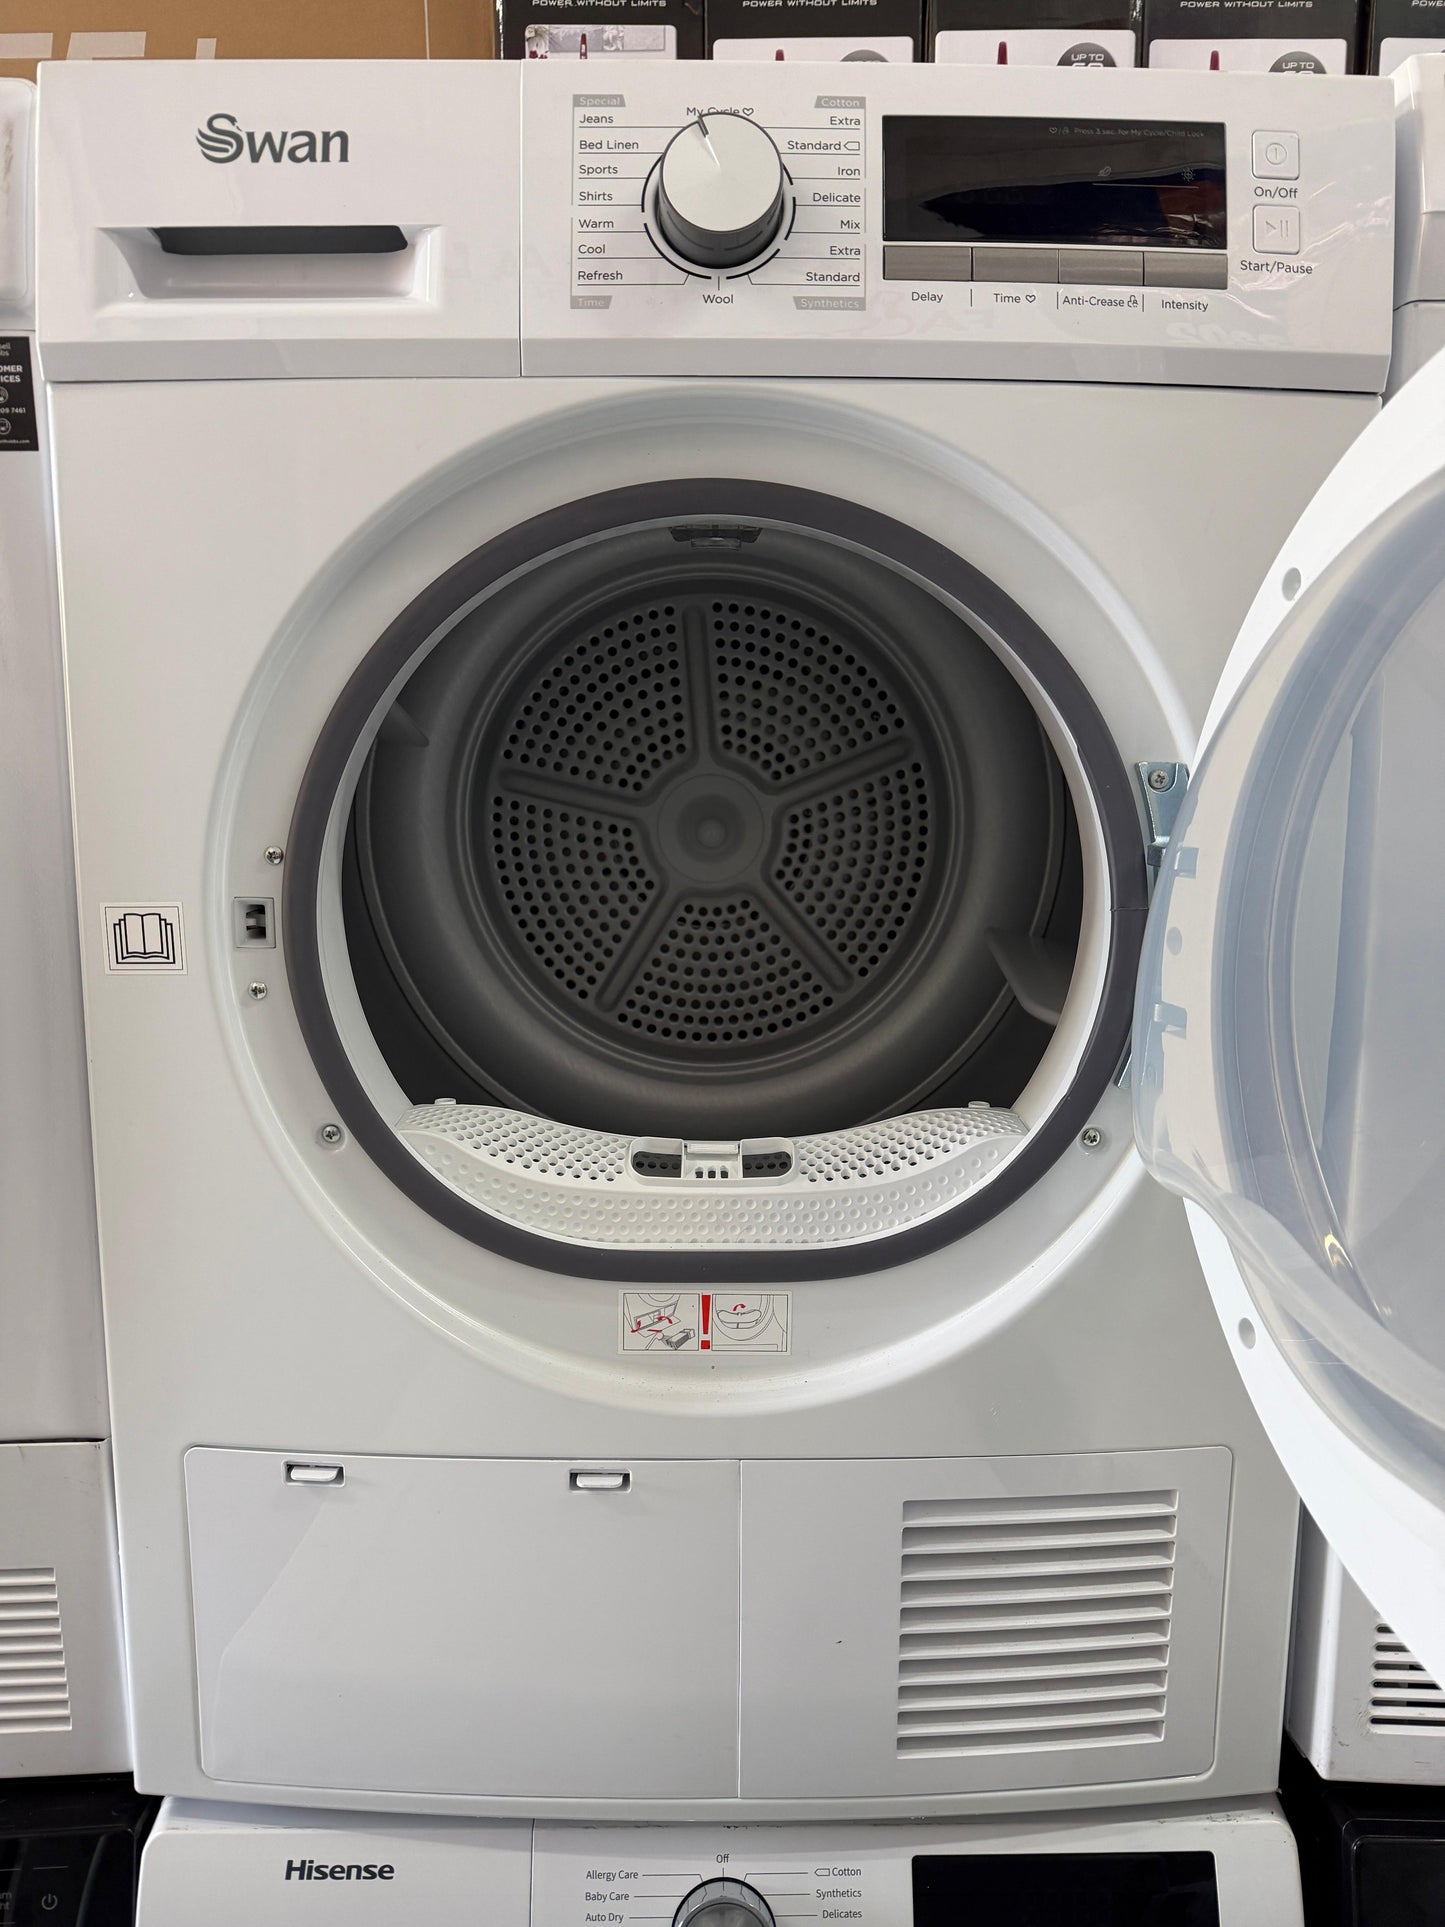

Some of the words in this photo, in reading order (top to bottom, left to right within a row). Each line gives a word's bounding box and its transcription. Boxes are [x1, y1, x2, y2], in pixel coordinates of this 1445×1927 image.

[1072, 53, 1087, 61] UP
[1088, 53, 1105, 62] TO
[1299, 62, 1315, 70] TO
[579, 96, 620, 106] Special
[821, 98, 860, 108] Cotton
[686, 107, 704, 118] My
[579, 114, 614, 124] Jeans
[830, 116, 860, 126] Extra
[194, 113, 349, 163] Swan
[579, 140, 602, 150] Bed
[607, 140, 639, 150] Linen
[788, 141, 842, 151] Standard
[579, 165, 618, 176] Sports
[838, 166, 860, 176] Iron
[579, 192, 612, 201] Shirts
[813, 192, 860, 202] Delicate
[1254, 186, 1298, 199] On/Off
[579, 220, 614, 228] Warm
[840, 220, 860, 229] Mix
[578, 244, 605, 254] Cool
[830, 246, 860, 256] Extra
[1240, 259, 1313, 276] Start/Pause
[578, 271, 622, 280] Refresh
[806, 272, 860, 282] Standard
[578, 299, 604, 307] Time
[703, 295, 733, 304] Wool
[800, 298, 859, 308] Synthetics
[911, 292, 943, 305] Delay
[993, 293, 1021, 304] Time
[1062, 296, 1125, 307] Anti-Crease
[1161, 299, 1209, 312] Intensity
[716, 1854, 729, 1863] Off
[285, 1859, 394, 1881] Hisense
[832, 1867, 861, 1876] Cotton
[586, 1870, 616, 1881] Allergy
[618, 1870, 638, 1879] Care
[585, 1892, 608, 1903] Baby
[609, 1892, 629, 1901] Care
[816, 1888, 862, 1900] Synthetics
[586, 1913, 607, 1922] Auto
[609, 1913, 624, 1924] Dry
[822, 1909, 862, 1919] Delicates
